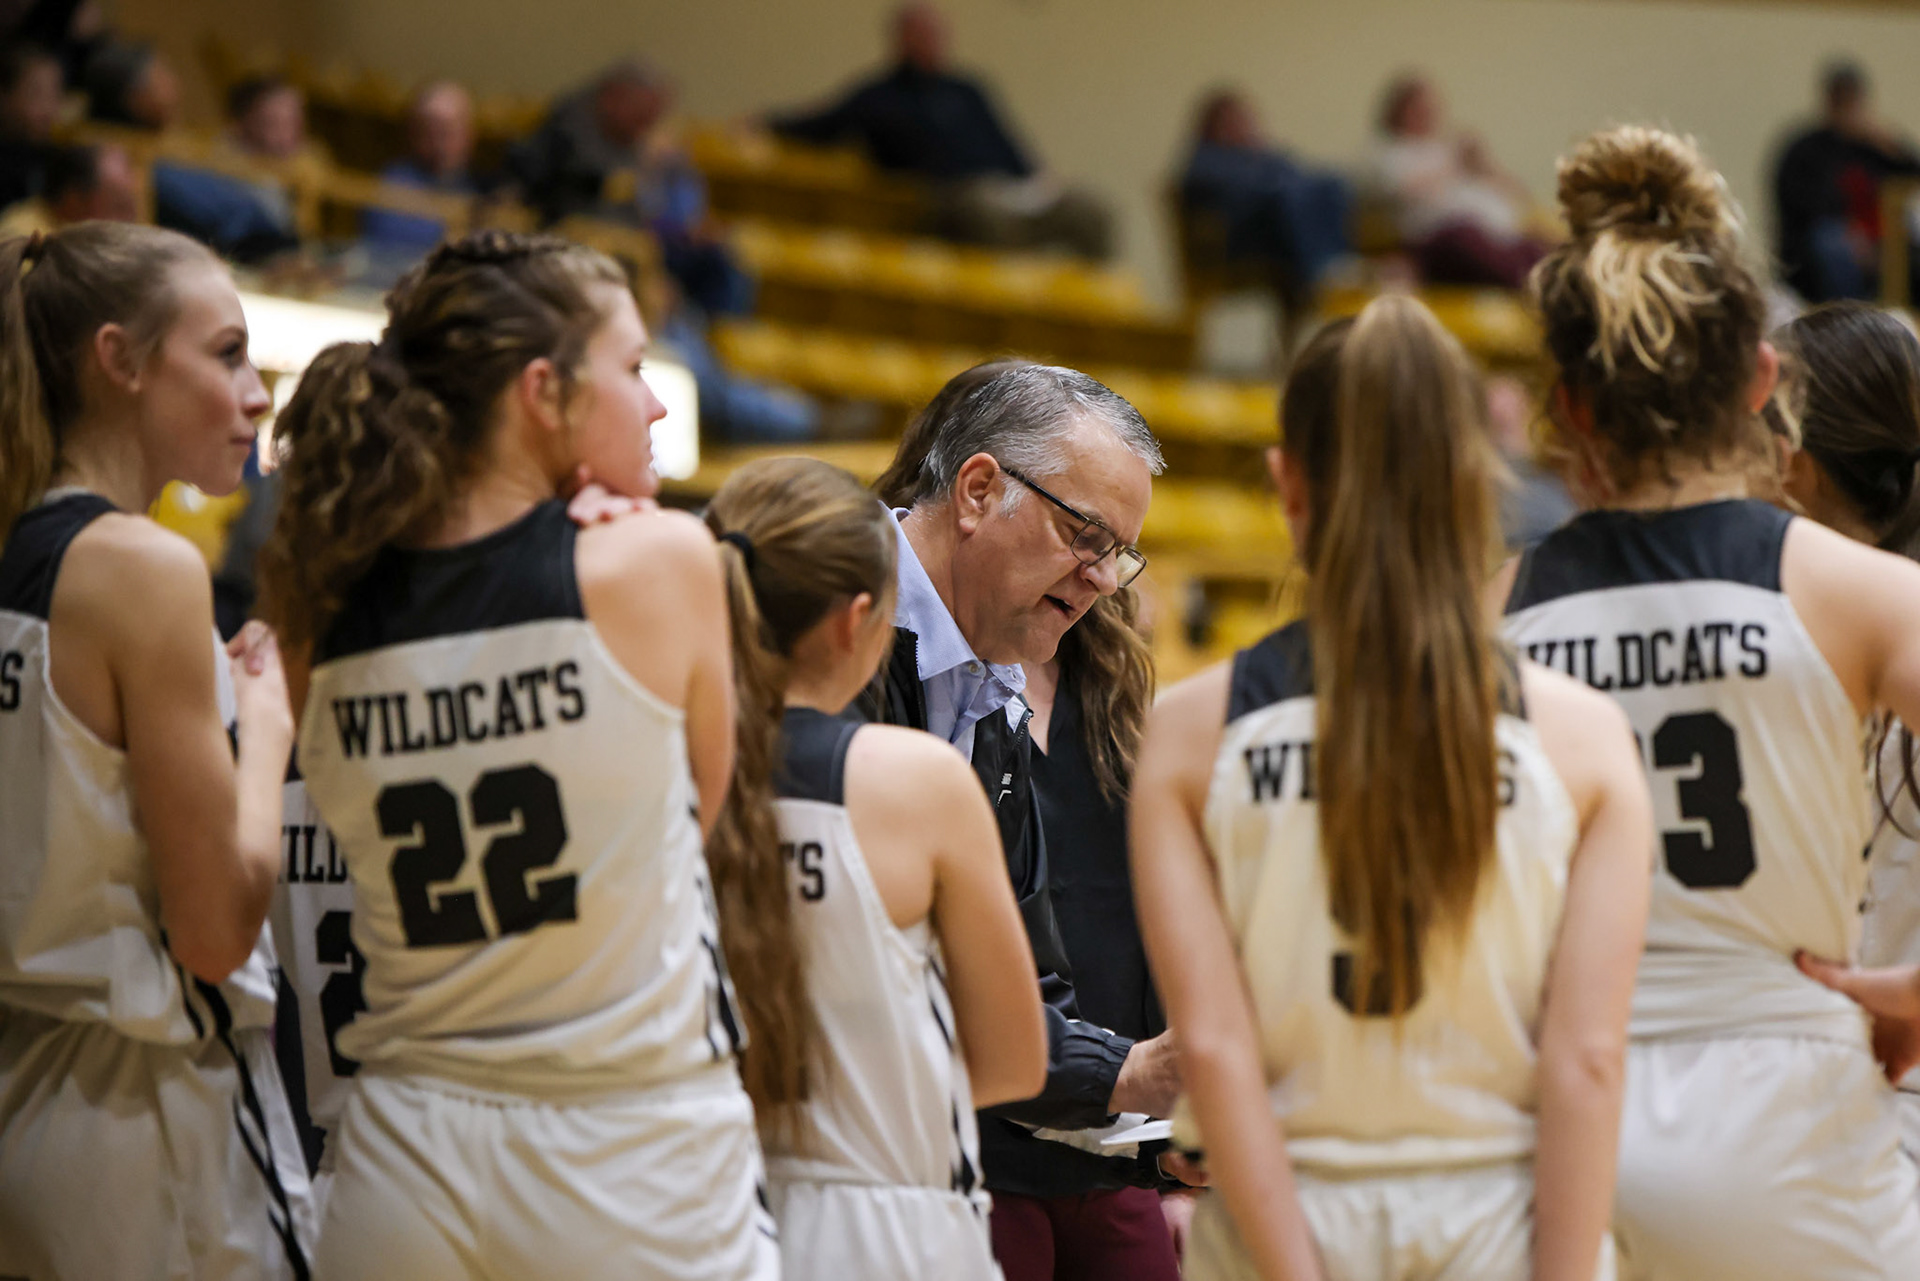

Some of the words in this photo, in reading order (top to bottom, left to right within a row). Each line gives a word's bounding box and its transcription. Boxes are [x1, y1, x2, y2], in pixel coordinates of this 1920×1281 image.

[1527, 622, 1767, 691] ILDCATS
[332, 660, 586, 759] WILDCATS
[1634, 710, 1758, 889] 3
[281, 825, 348, 884] ILD
[374, 762, 579, 949] 22
